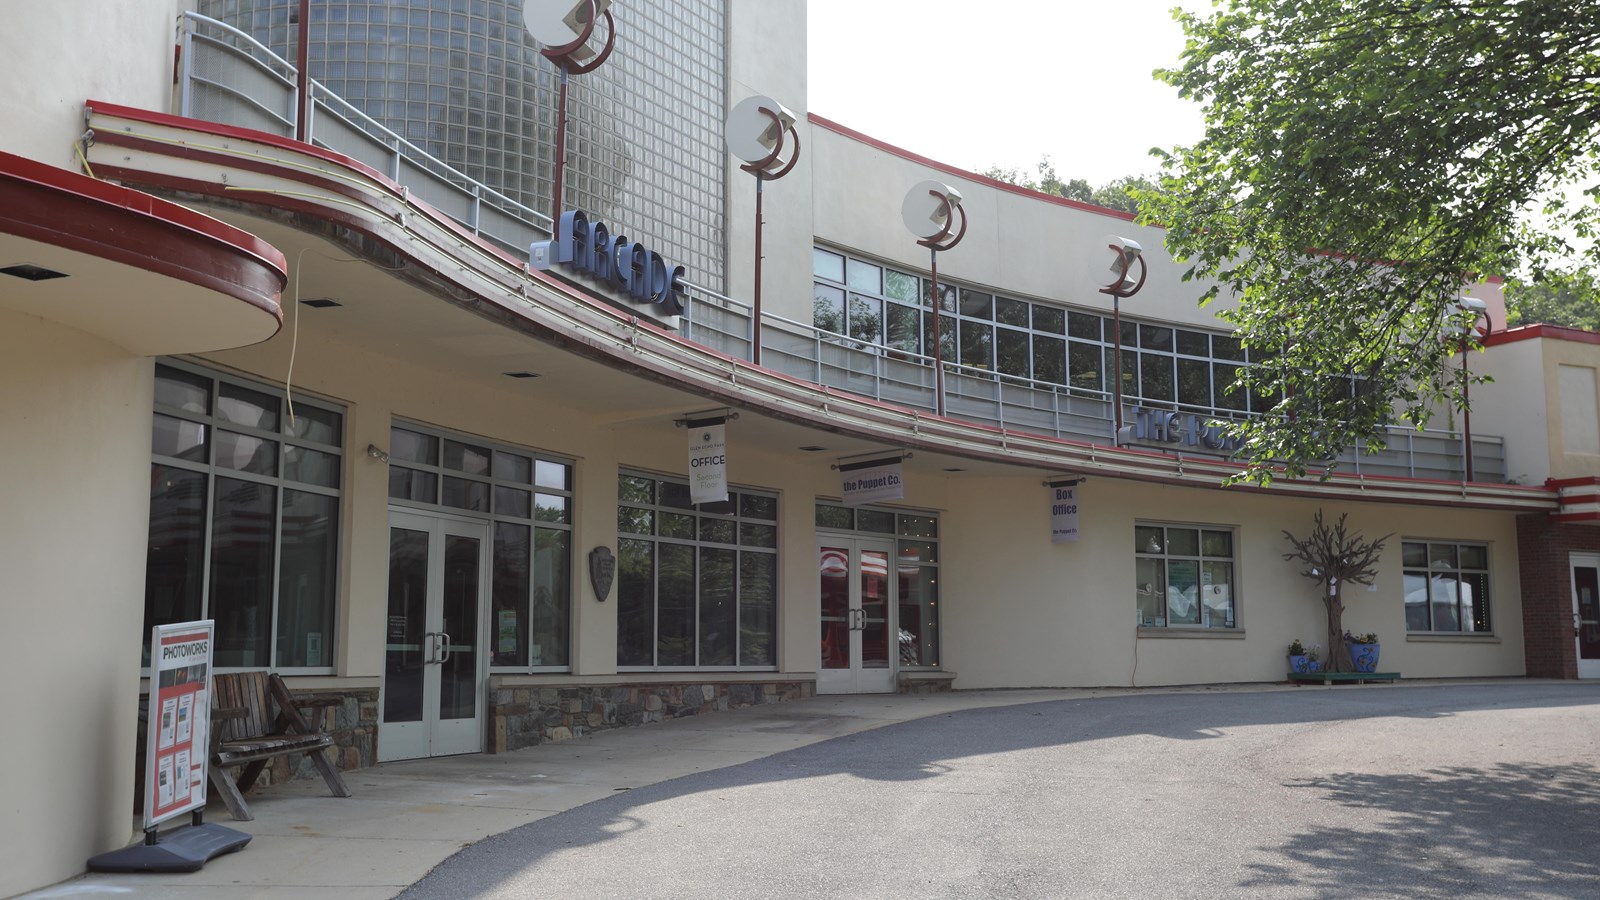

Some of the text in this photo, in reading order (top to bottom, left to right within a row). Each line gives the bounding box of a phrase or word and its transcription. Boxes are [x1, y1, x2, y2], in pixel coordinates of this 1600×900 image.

[559, 210, 685, 315] ARCADE
[1131, 406, 1184, 443] THE
[691, 455, 725, 468] OFFICE
[696, 472, 721, 482] Second
[843, 481, 857, 492] the
[858, 476, 887, 490] Puppet
[887, 474, 901, 486] Co.
[1056, 489, 1073, 500] Box
[1052, 504, 1077, 516] Office
[163, 641, 208, 660] PHOTOWORKS
